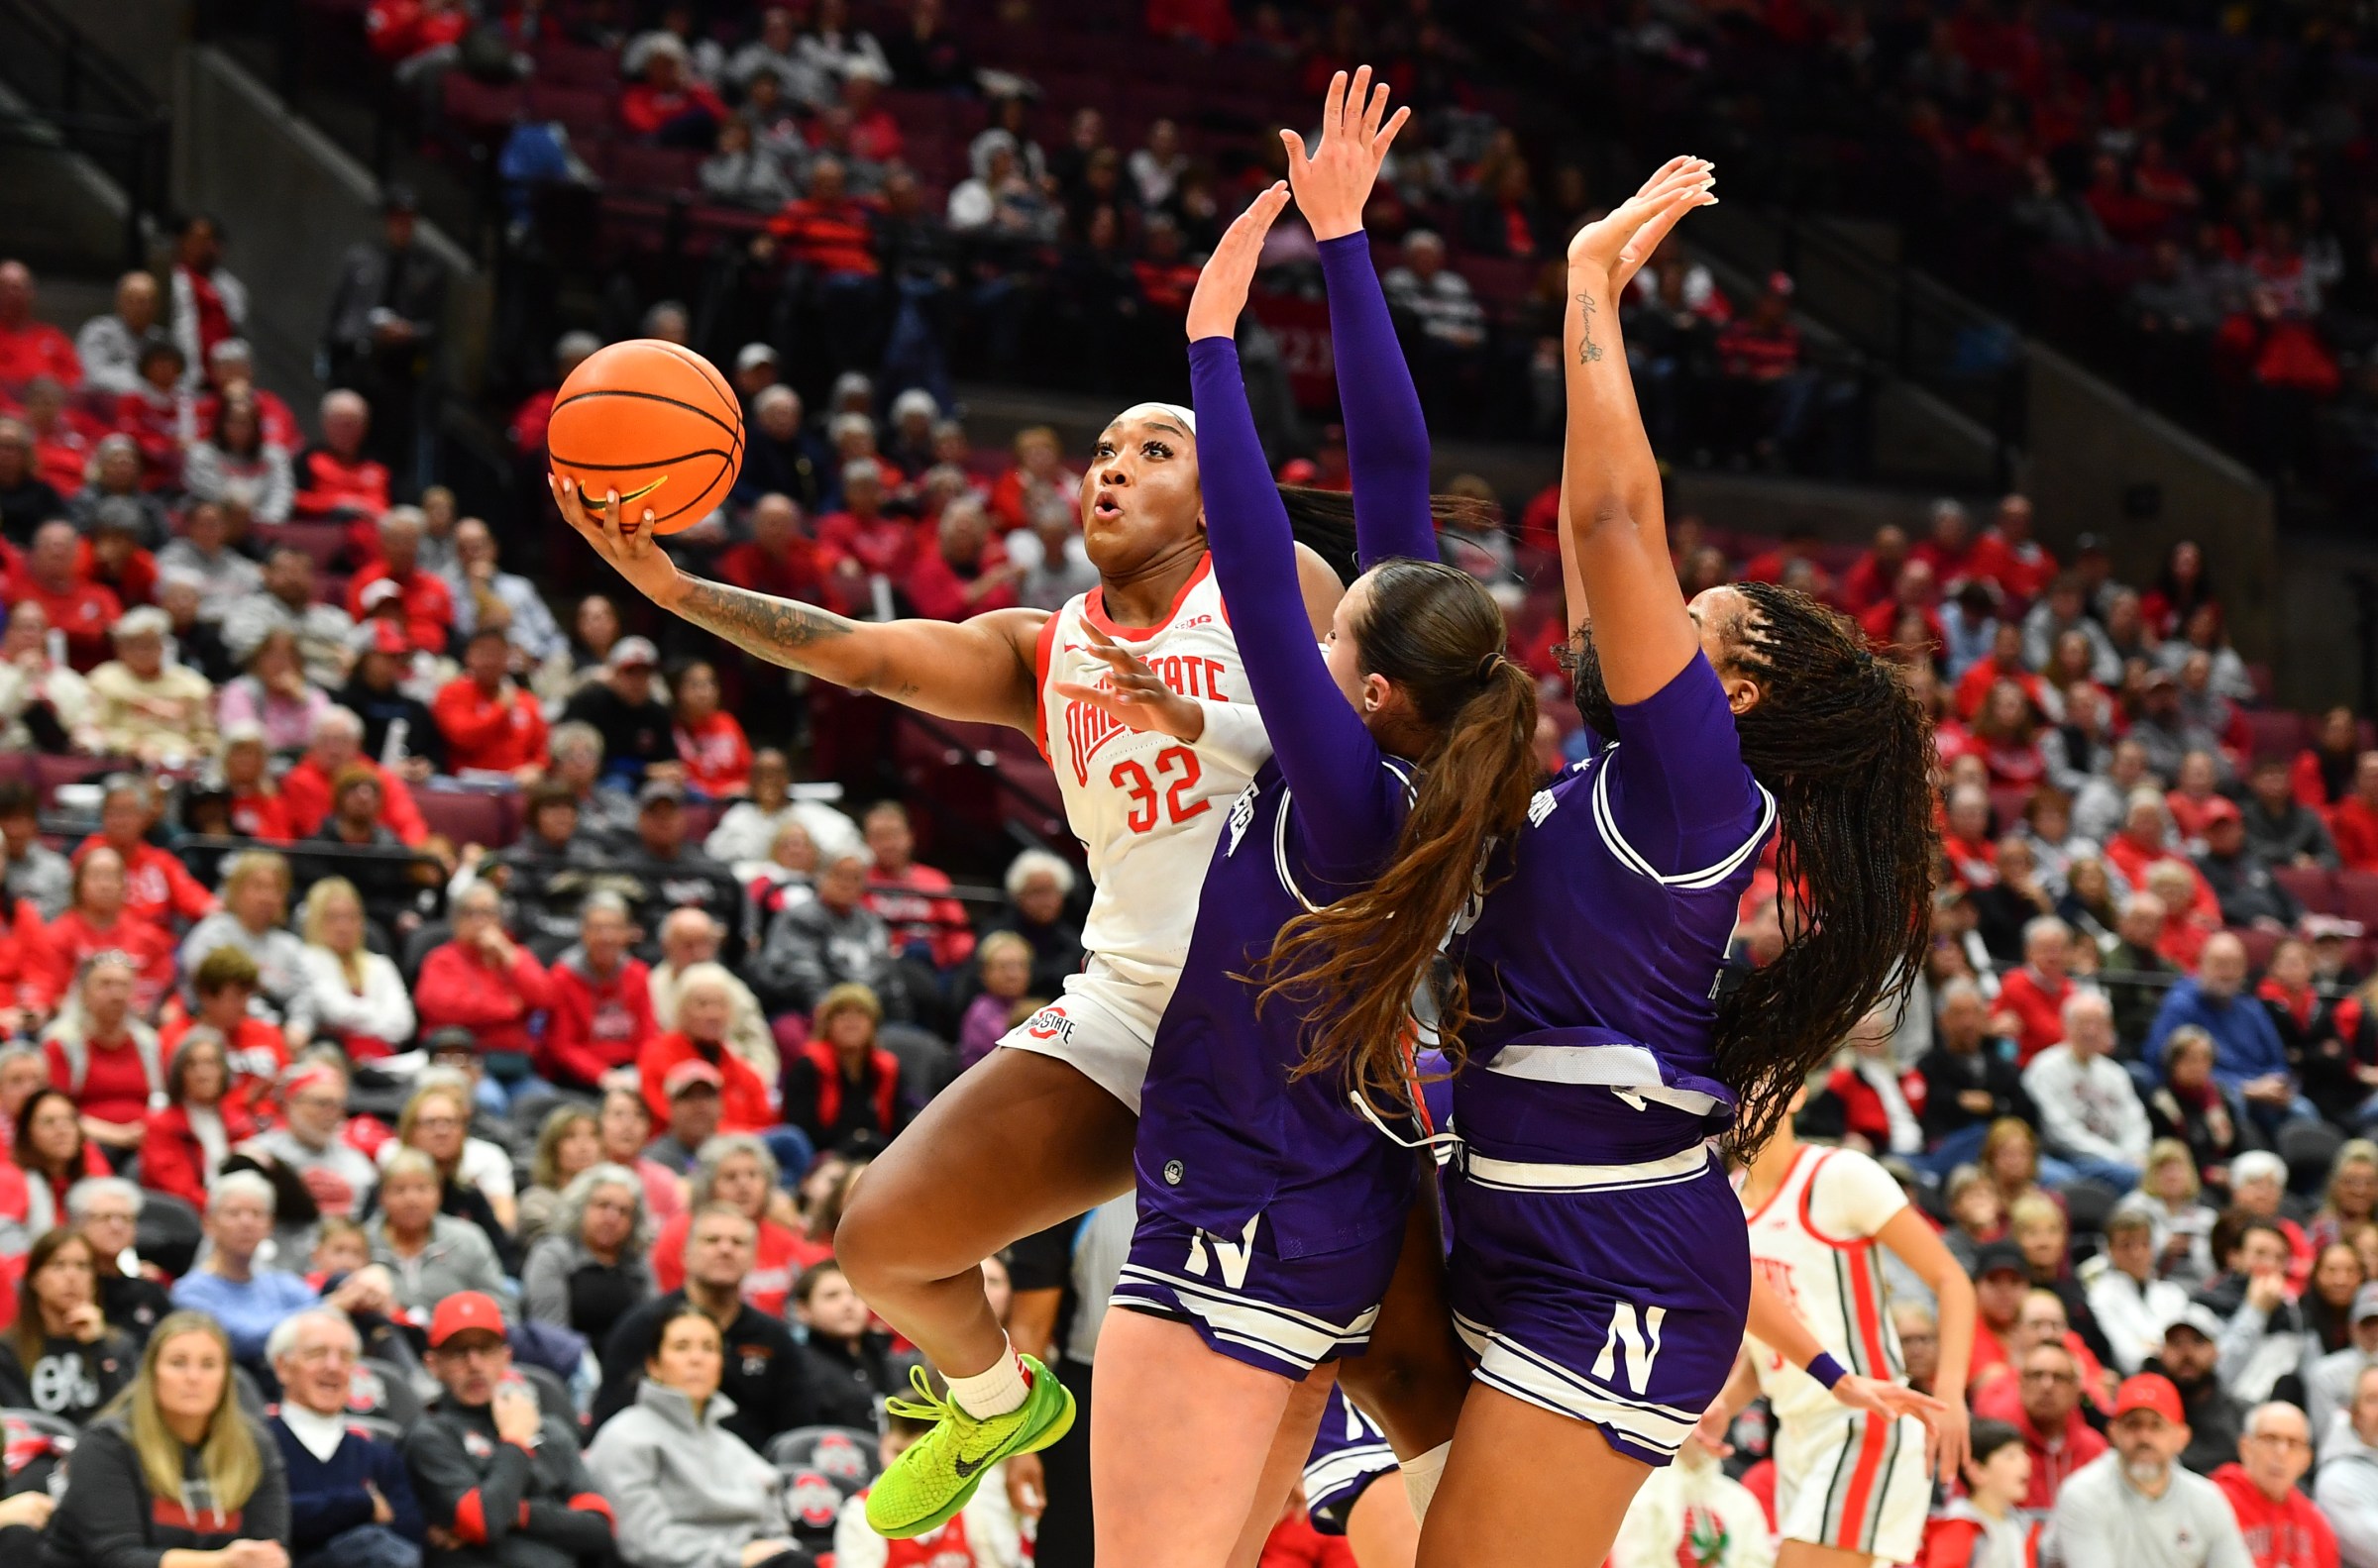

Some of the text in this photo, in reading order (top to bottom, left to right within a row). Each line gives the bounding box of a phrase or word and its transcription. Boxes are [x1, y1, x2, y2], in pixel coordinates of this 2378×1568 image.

[1137, 655, 1230, 704] TATE
[1108, 745, 1213, 834] 32
[1039, 1012, 1076, 1045] STATE
[1183, 1211, 1259, 1290] N
[1590, 1300, 1668, 1396] N
